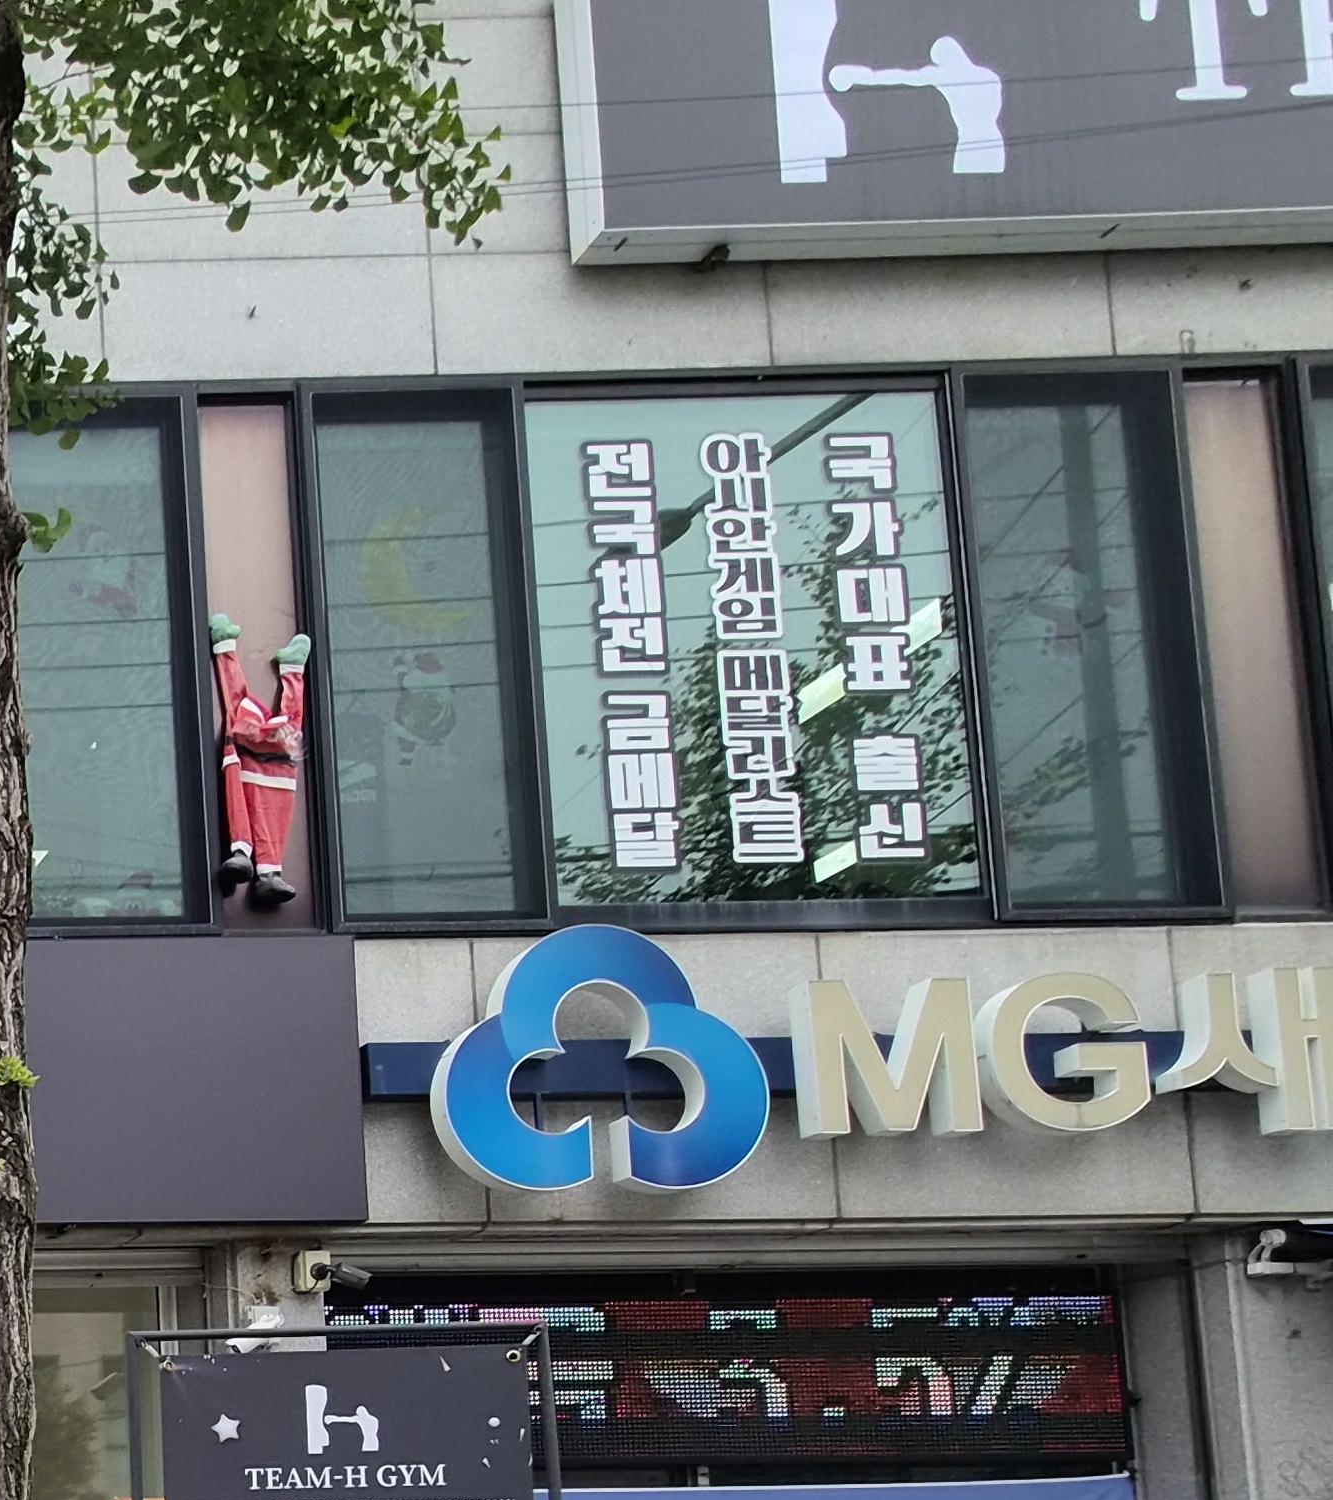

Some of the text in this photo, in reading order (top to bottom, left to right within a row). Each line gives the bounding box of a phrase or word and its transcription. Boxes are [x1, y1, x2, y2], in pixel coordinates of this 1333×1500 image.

[582, 438, 683, 874] 전국체전 금메달
[700, 432, 806, 864] 아시안게임 메달리스트
[824, 431, 932, 862] 국가대표 출신
[244, 1462, 448, 1491] TEAM-H GYM
